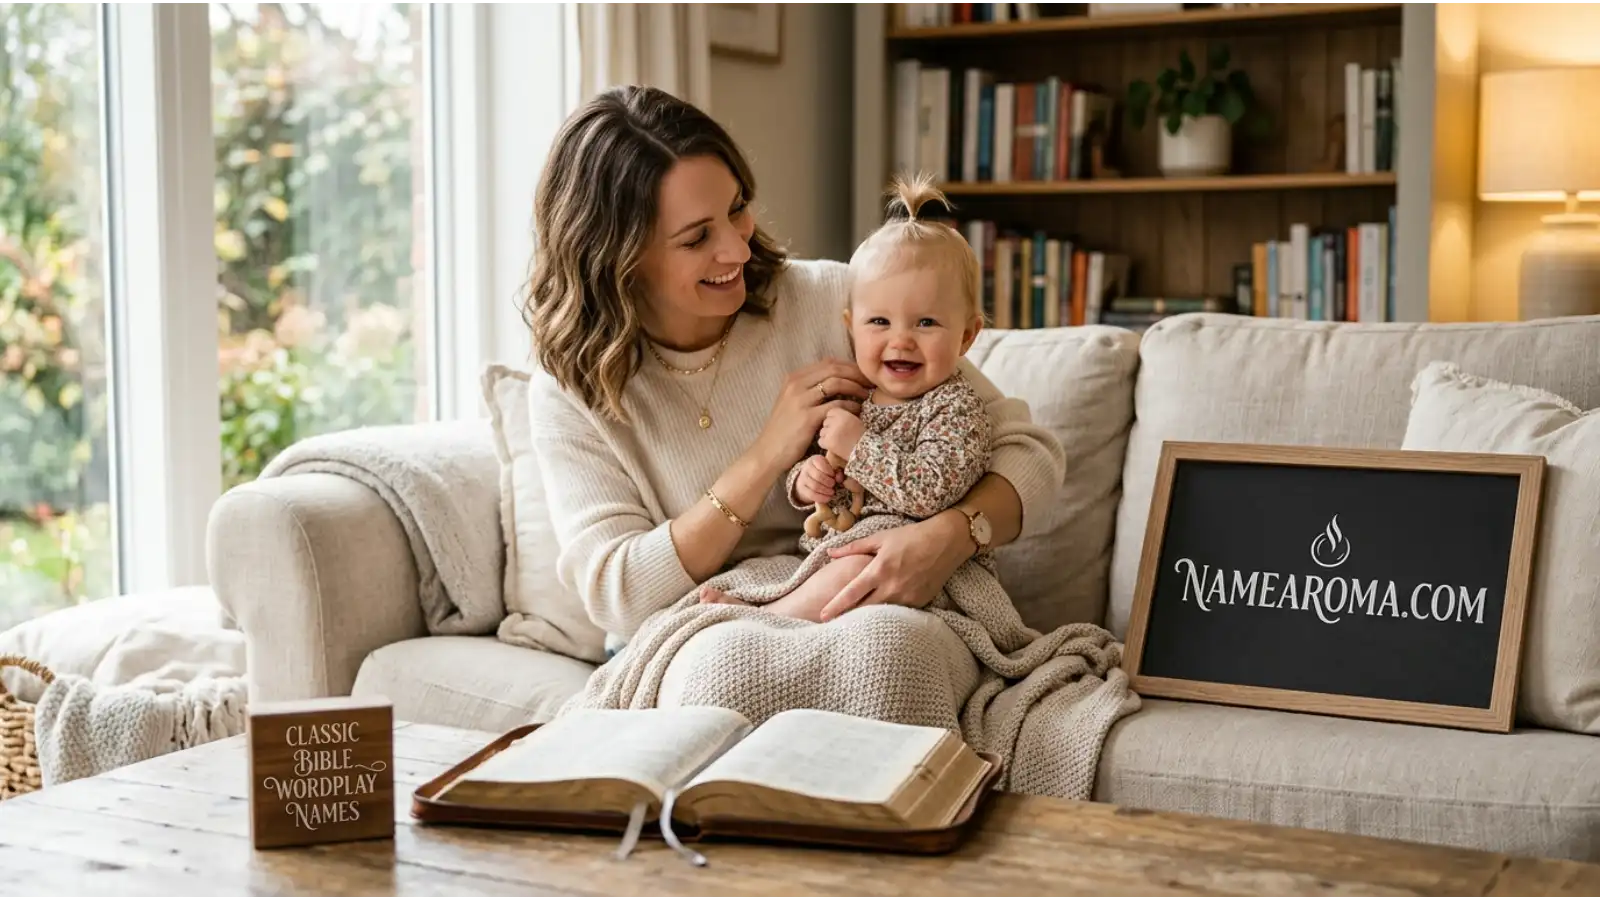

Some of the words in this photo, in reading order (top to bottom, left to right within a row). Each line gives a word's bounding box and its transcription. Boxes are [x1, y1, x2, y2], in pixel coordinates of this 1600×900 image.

[1174, 557, 1488, 624] NAMEAROMA.COM
[285, 721, 360, 747] CLASSIC
[293, 748, 387, 777] BIBLE
[263, 773, 378, 800] WORDPLAY
[285, 800, 360, 831] NAMES
